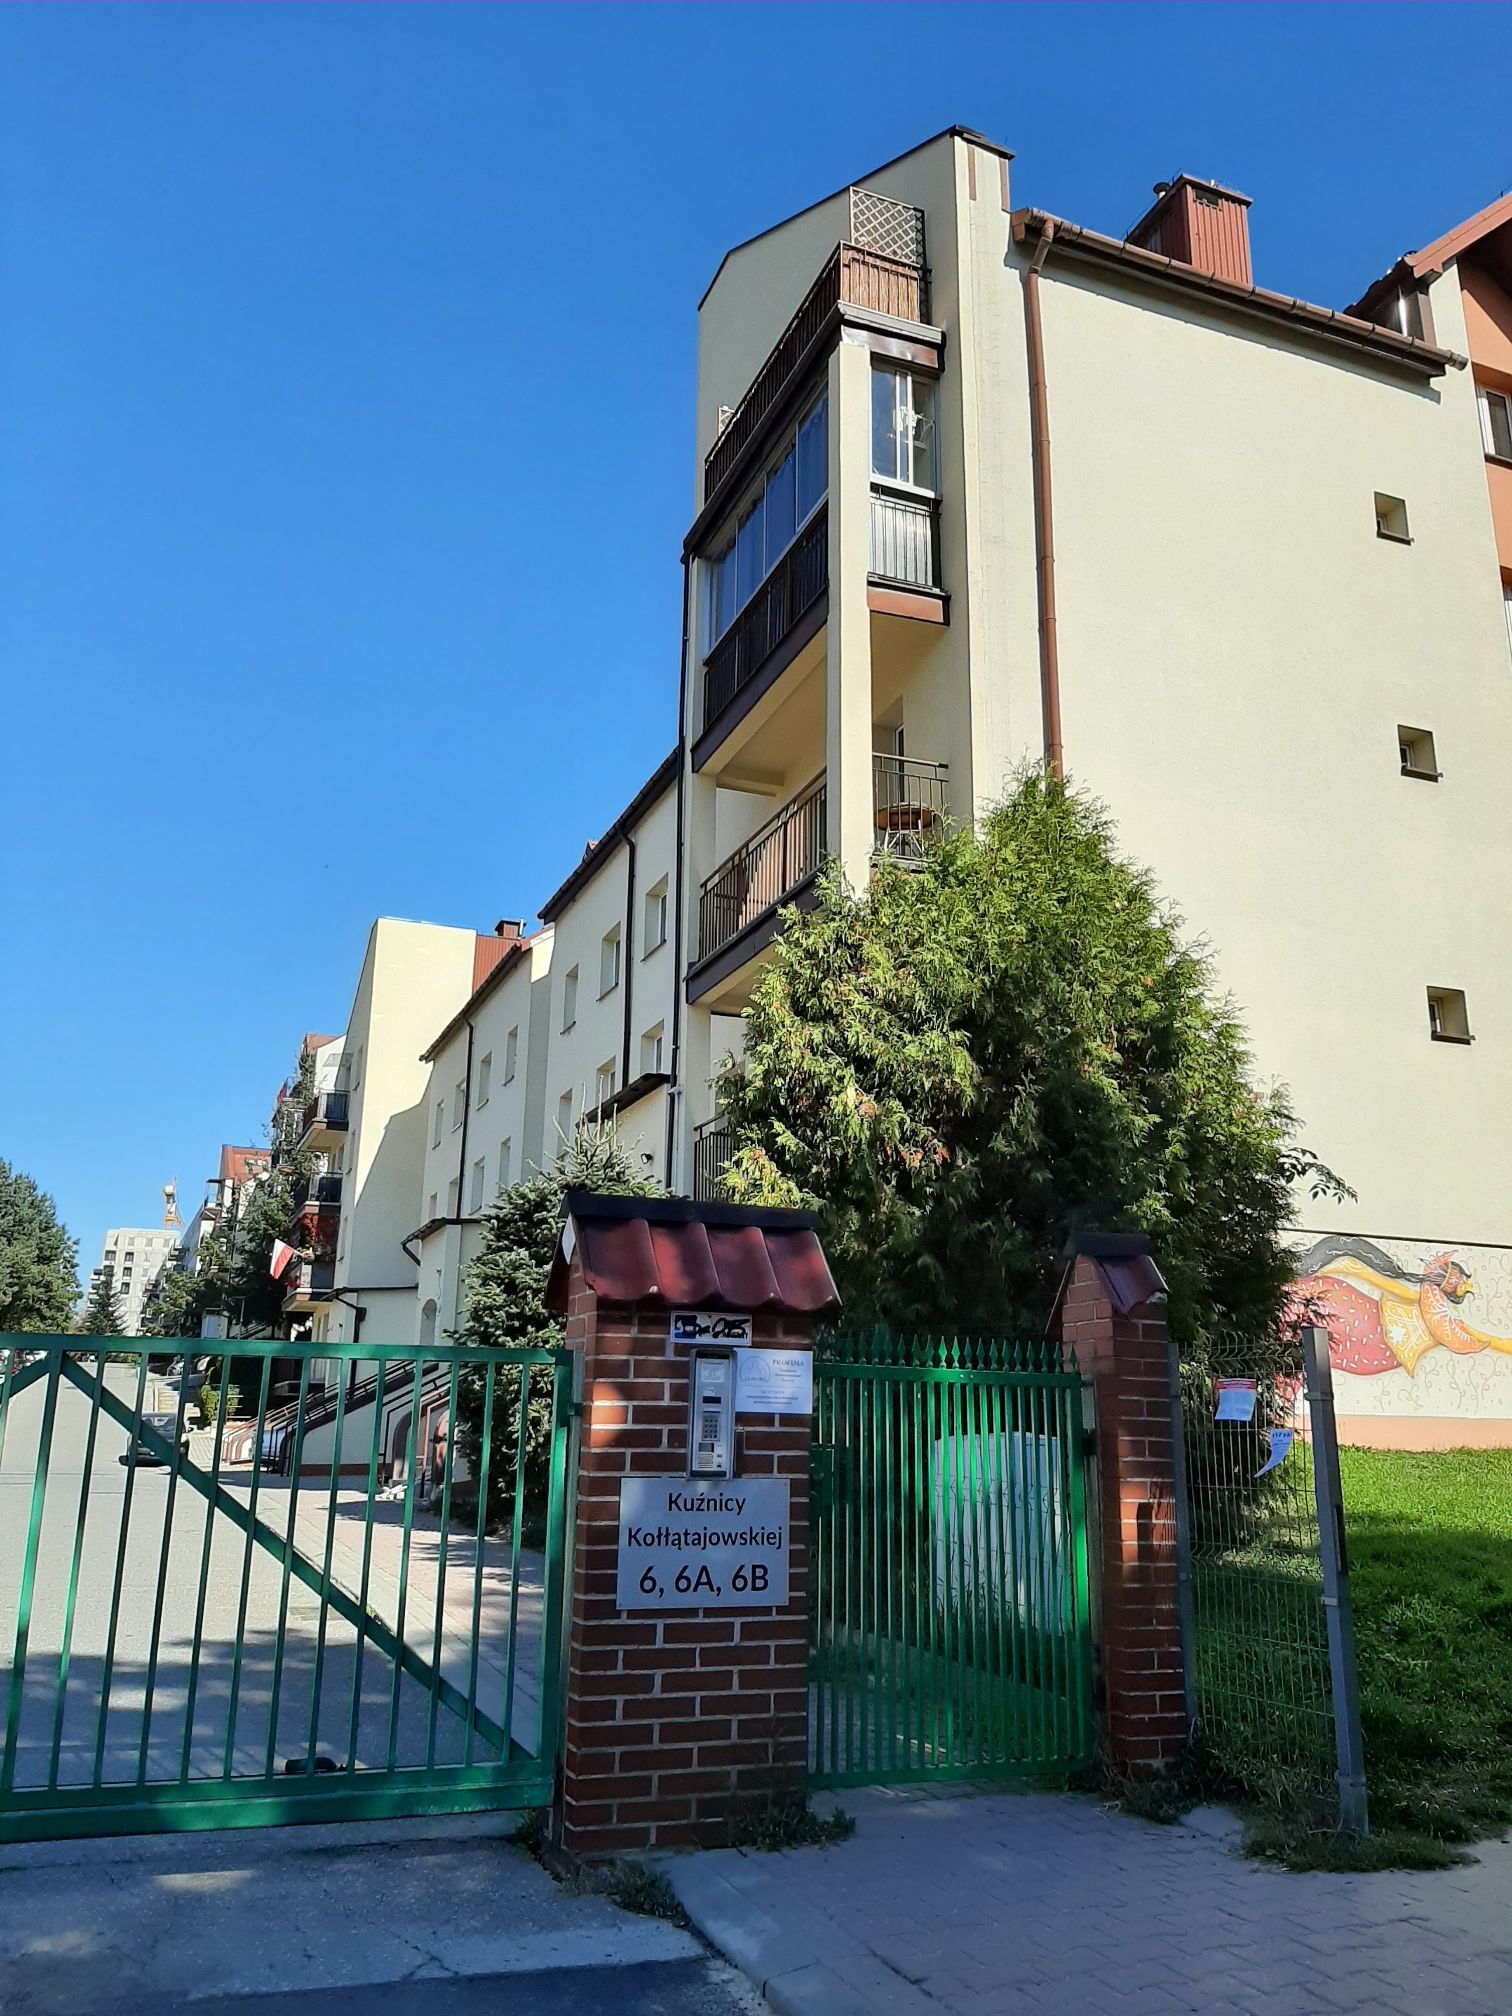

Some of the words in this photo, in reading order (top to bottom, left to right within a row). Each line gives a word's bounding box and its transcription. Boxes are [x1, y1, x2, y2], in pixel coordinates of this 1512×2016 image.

[668, 1492, 746, 1516] Kuźnicy
[627, 1526, 782, 1551] Kołłątajowskiej
[639, 1565, 664, 1598] 6,
[674, 1564, 721, 1597] 6A,
[731, 1564, 768, 1592] 6B
